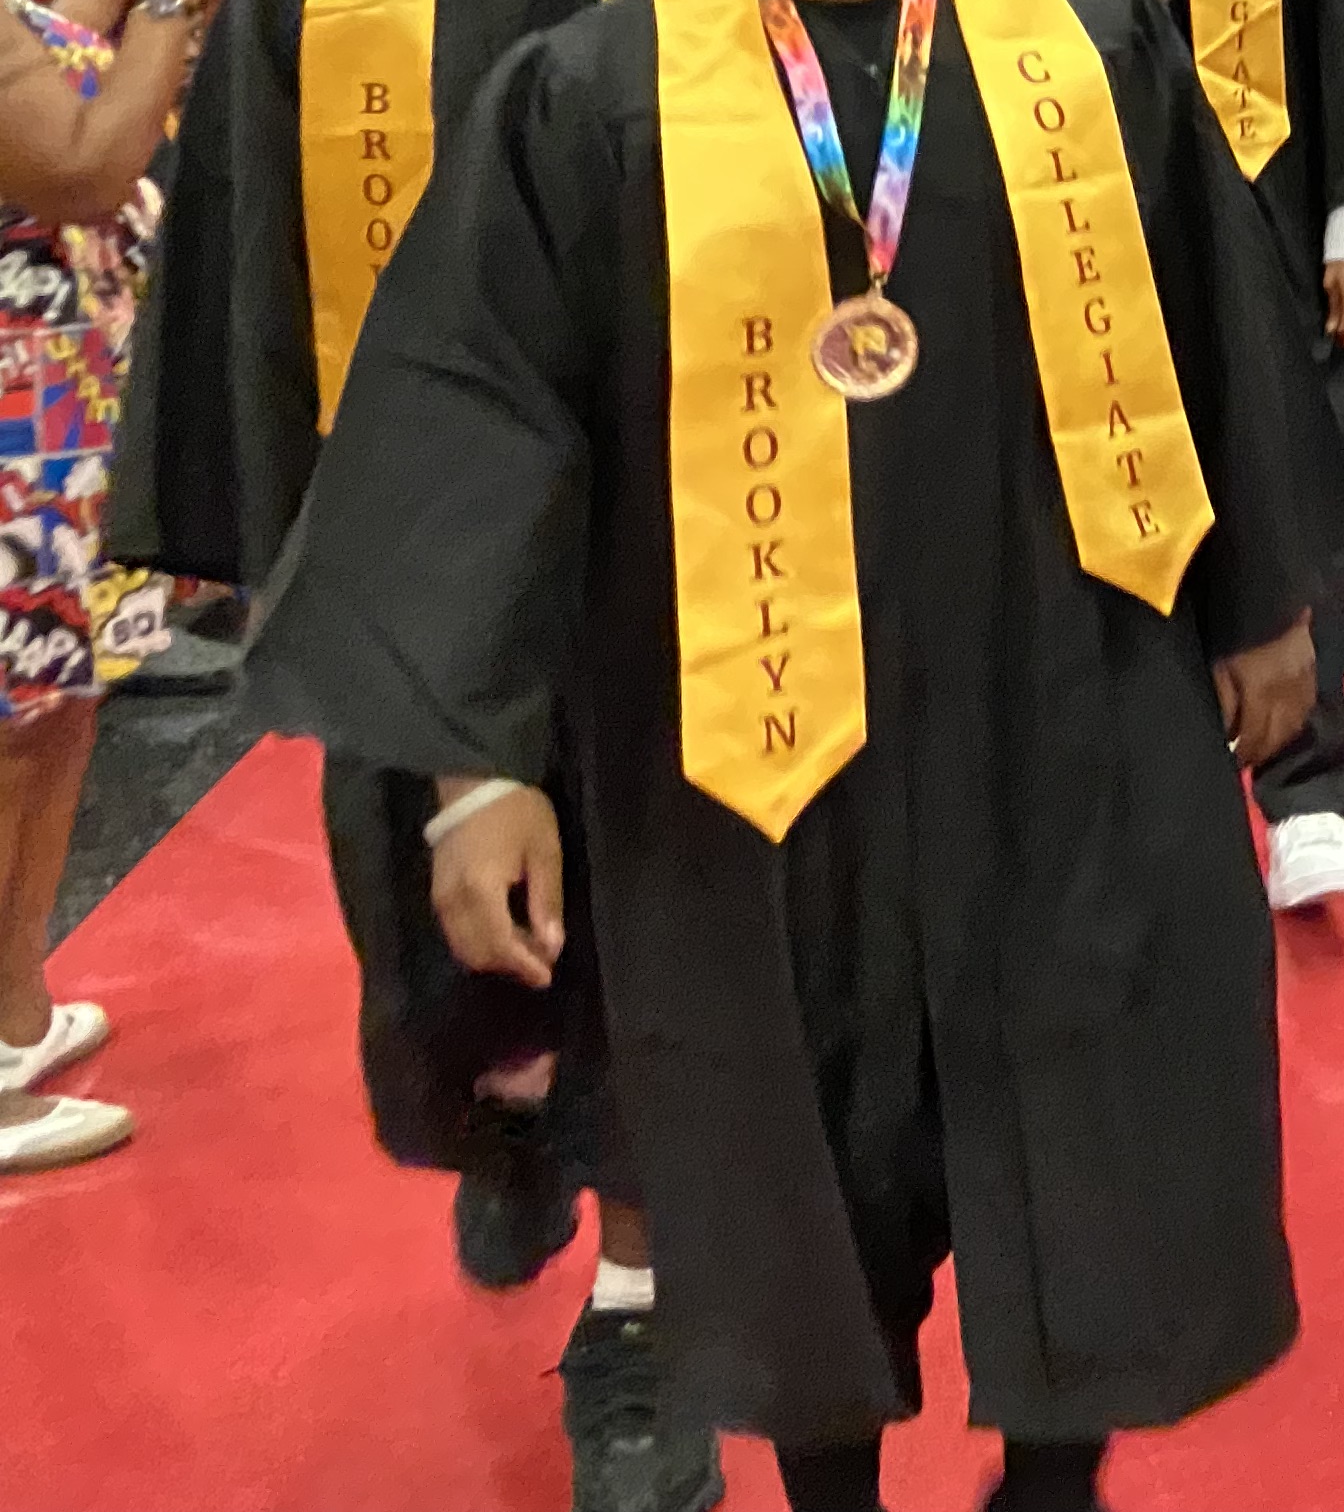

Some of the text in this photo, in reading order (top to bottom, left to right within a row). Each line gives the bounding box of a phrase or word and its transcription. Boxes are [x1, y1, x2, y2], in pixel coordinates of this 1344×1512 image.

[360, 82, 392, 275] BROO
[1016, 49, 1160, 540] COLLEGIATE
[740, 315, 798, 757] BROOKLYN
